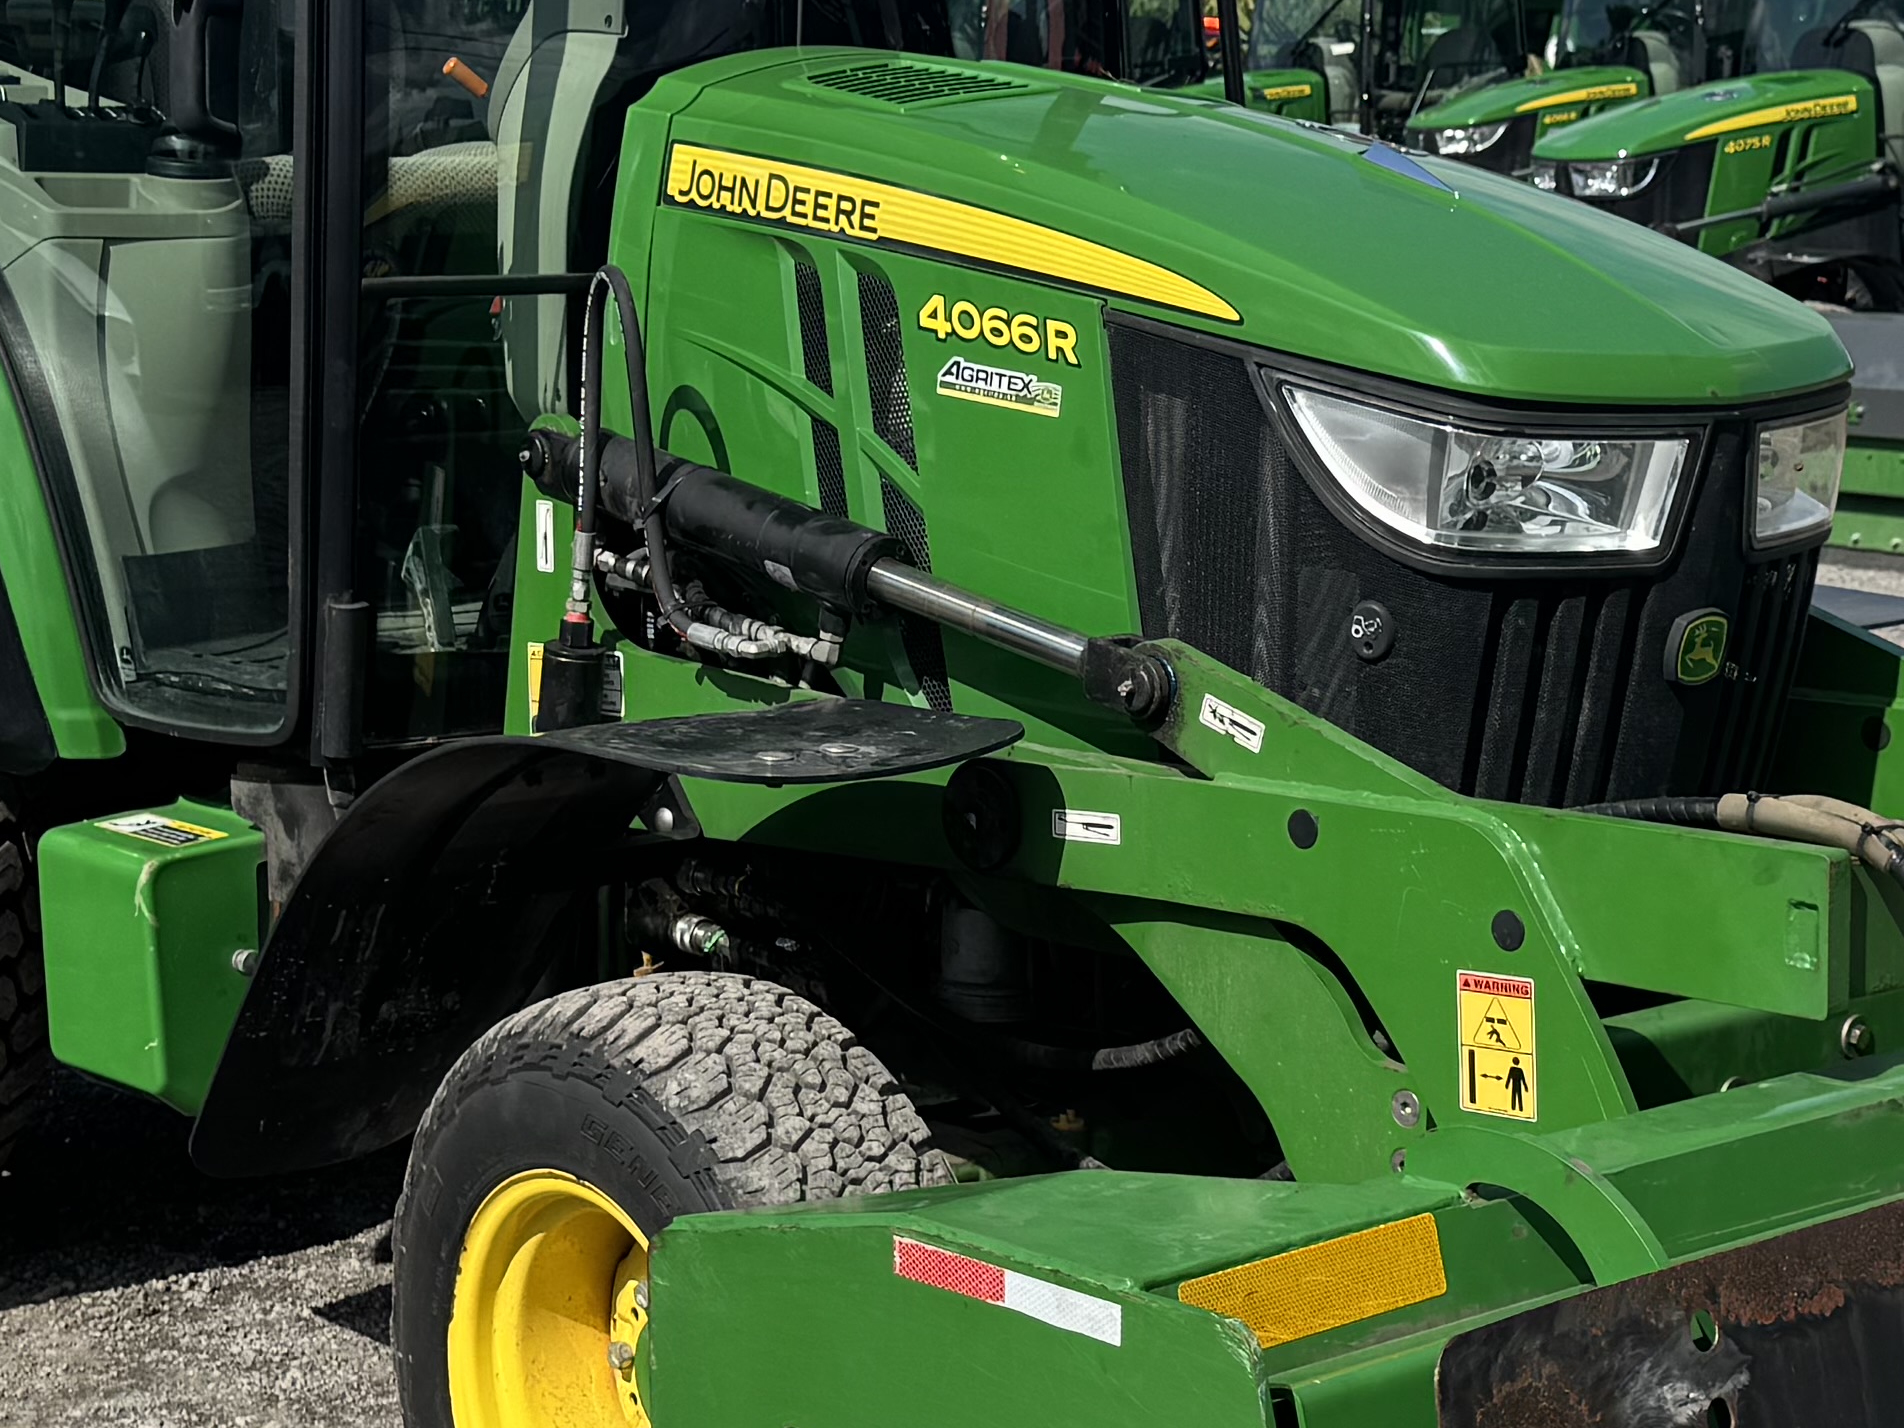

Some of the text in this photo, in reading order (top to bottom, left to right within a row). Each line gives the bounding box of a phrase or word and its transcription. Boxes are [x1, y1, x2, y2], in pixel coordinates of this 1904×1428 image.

[677, 158, 881, 235] JOHN DEERE
[941, 359, 1034, 396] AGRITEX
[1473, 978, 1530, 997] WARNING
[580, 1113, 683, 1218] GENE
